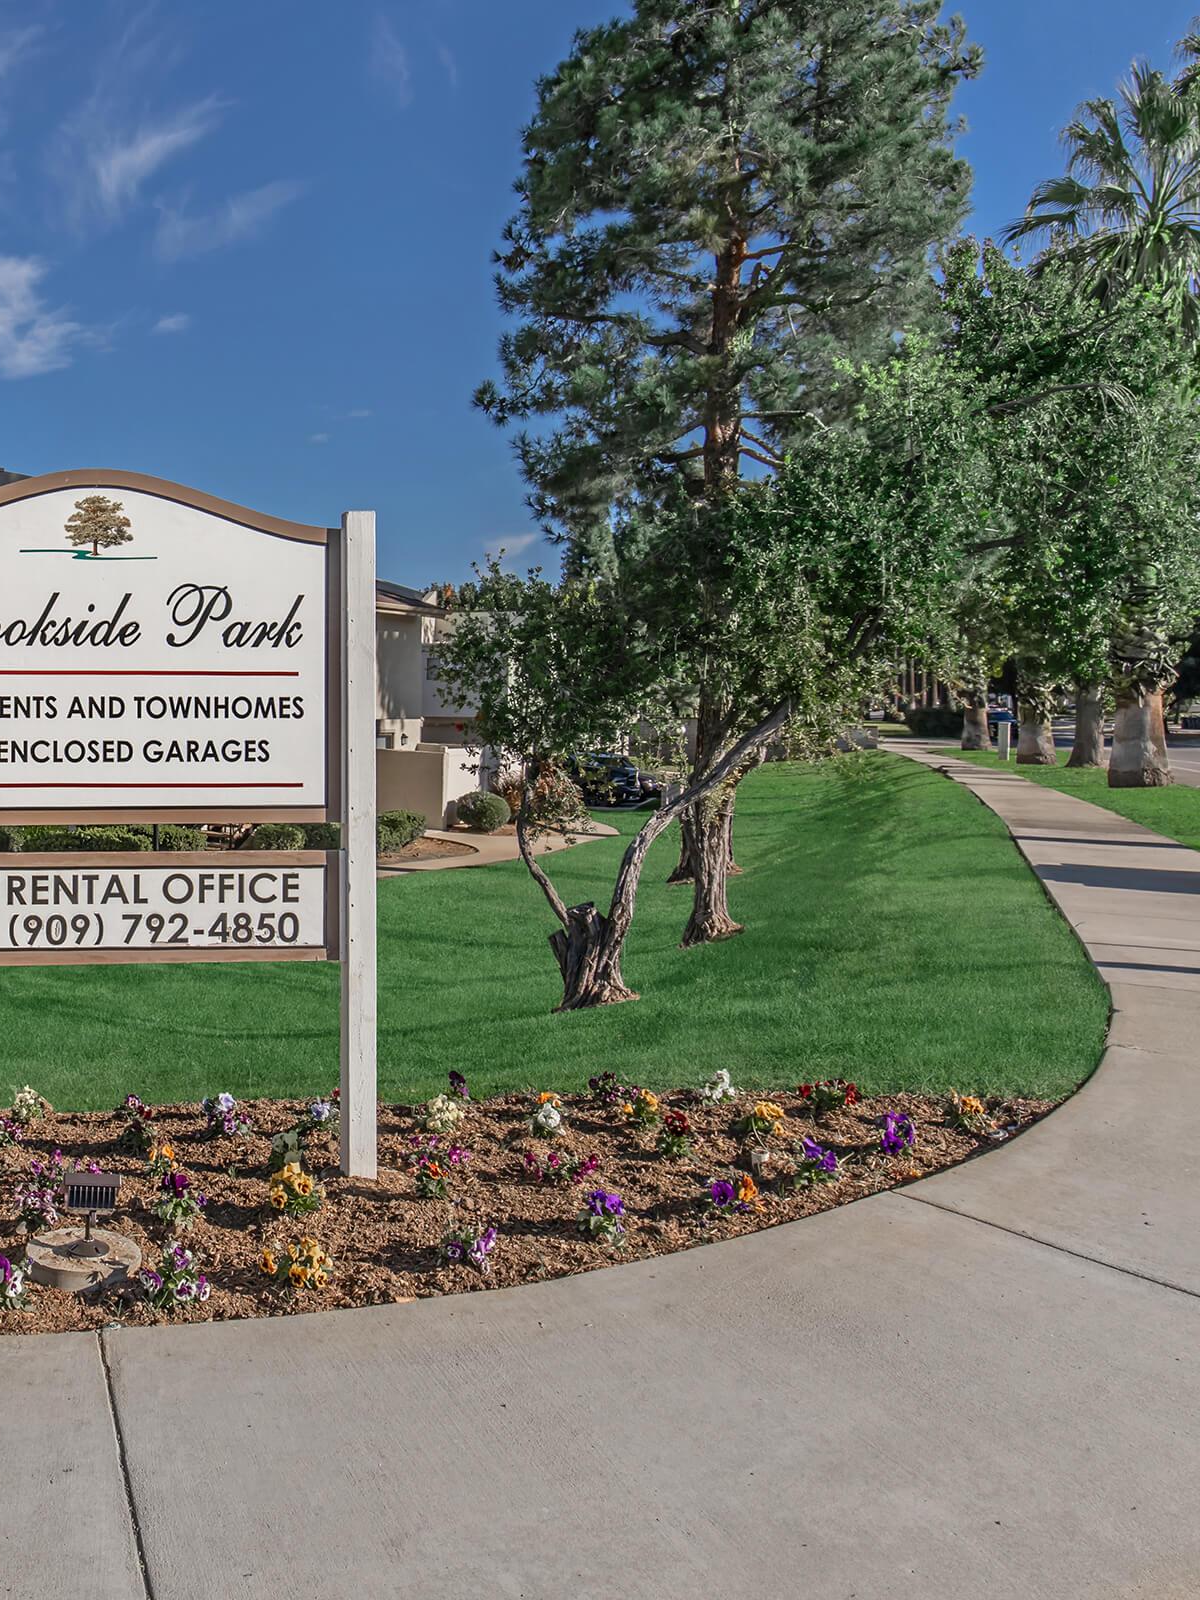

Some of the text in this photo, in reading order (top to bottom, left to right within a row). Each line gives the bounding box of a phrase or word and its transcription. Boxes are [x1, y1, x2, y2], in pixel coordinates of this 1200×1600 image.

[165, 583, 305, 649] Park
[66, 695, 126, 719] AND
[133, 695, 305, 720] TOWNHOMES
[142, 739, 270, 763] GARAGES
[7, 872, 300, 906] RENTAL OFFICE
[8, 912, 300, 946] (909) 792-4850
